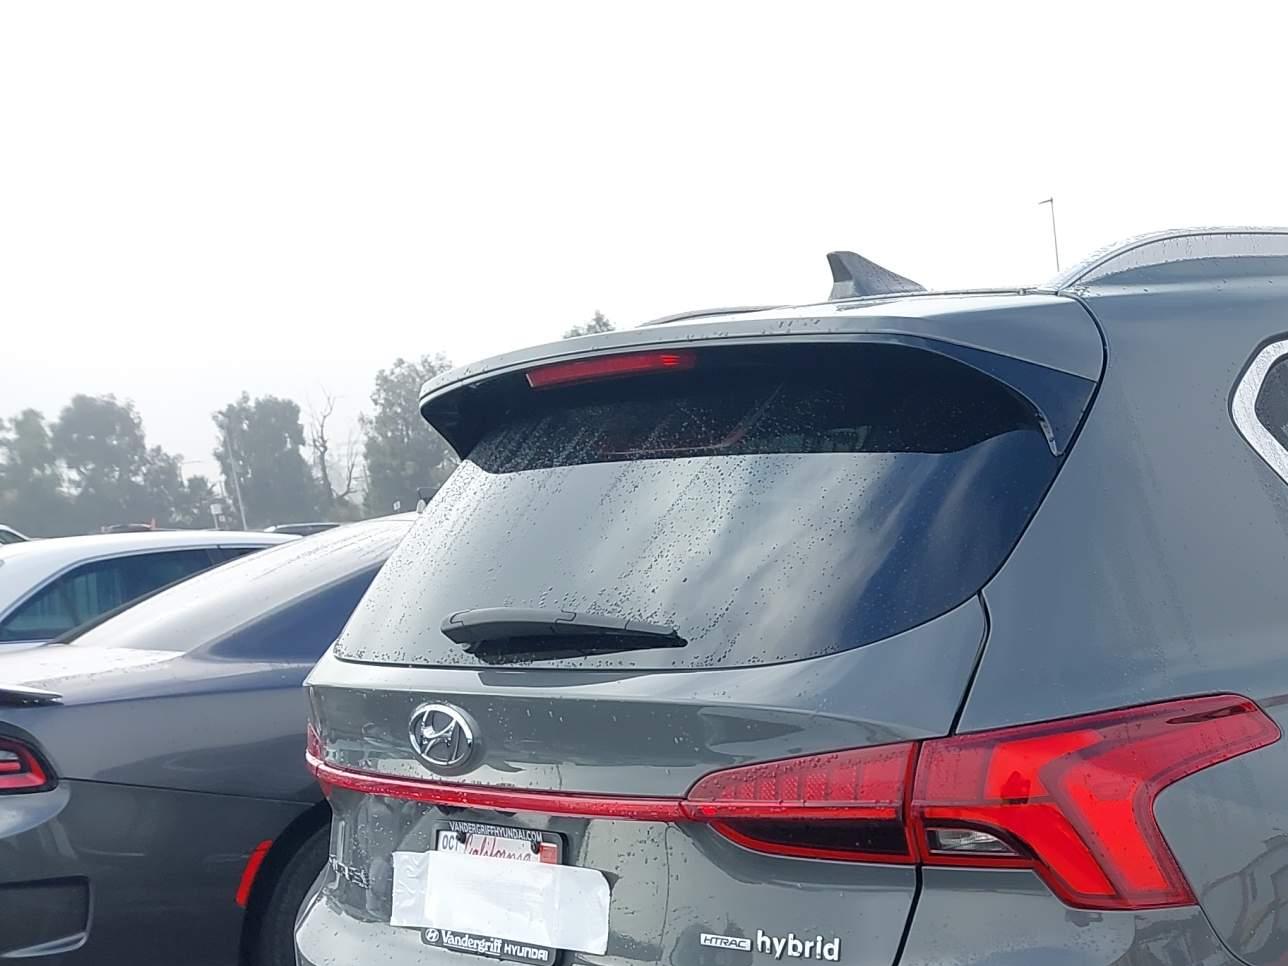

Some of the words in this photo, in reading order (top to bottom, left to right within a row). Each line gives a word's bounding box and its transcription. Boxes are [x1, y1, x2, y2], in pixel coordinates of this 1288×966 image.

[449, 821, 543, 842] VANDERGRIFFHYUNDAI.COM
[441, 929, 503, 953] Vandergriff
[503, 943, 549, 961] HYUNDAI
[702, 935, 749, 949] HTRAC
[756, 929, 841, 961] hybrid
